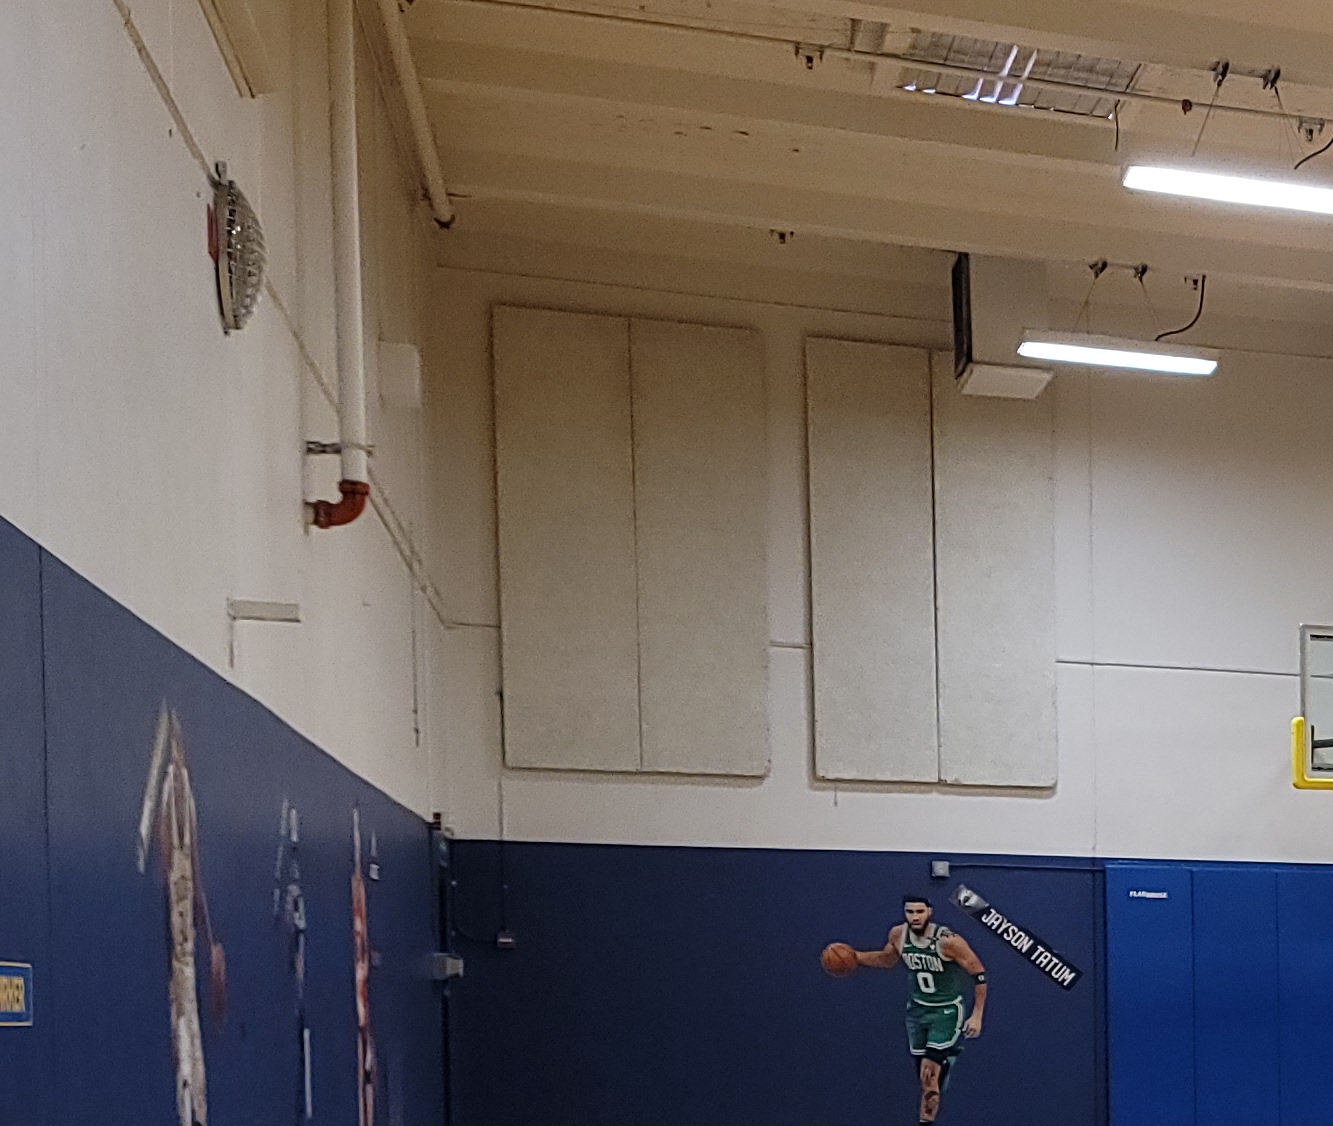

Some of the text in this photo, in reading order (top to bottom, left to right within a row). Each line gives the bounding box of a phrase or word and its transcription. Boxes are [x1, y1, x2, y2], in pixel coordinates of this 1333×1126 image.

[981, 907, 1077, 987] JAYSON TATUM
[916, 971, 936, 994] 0
